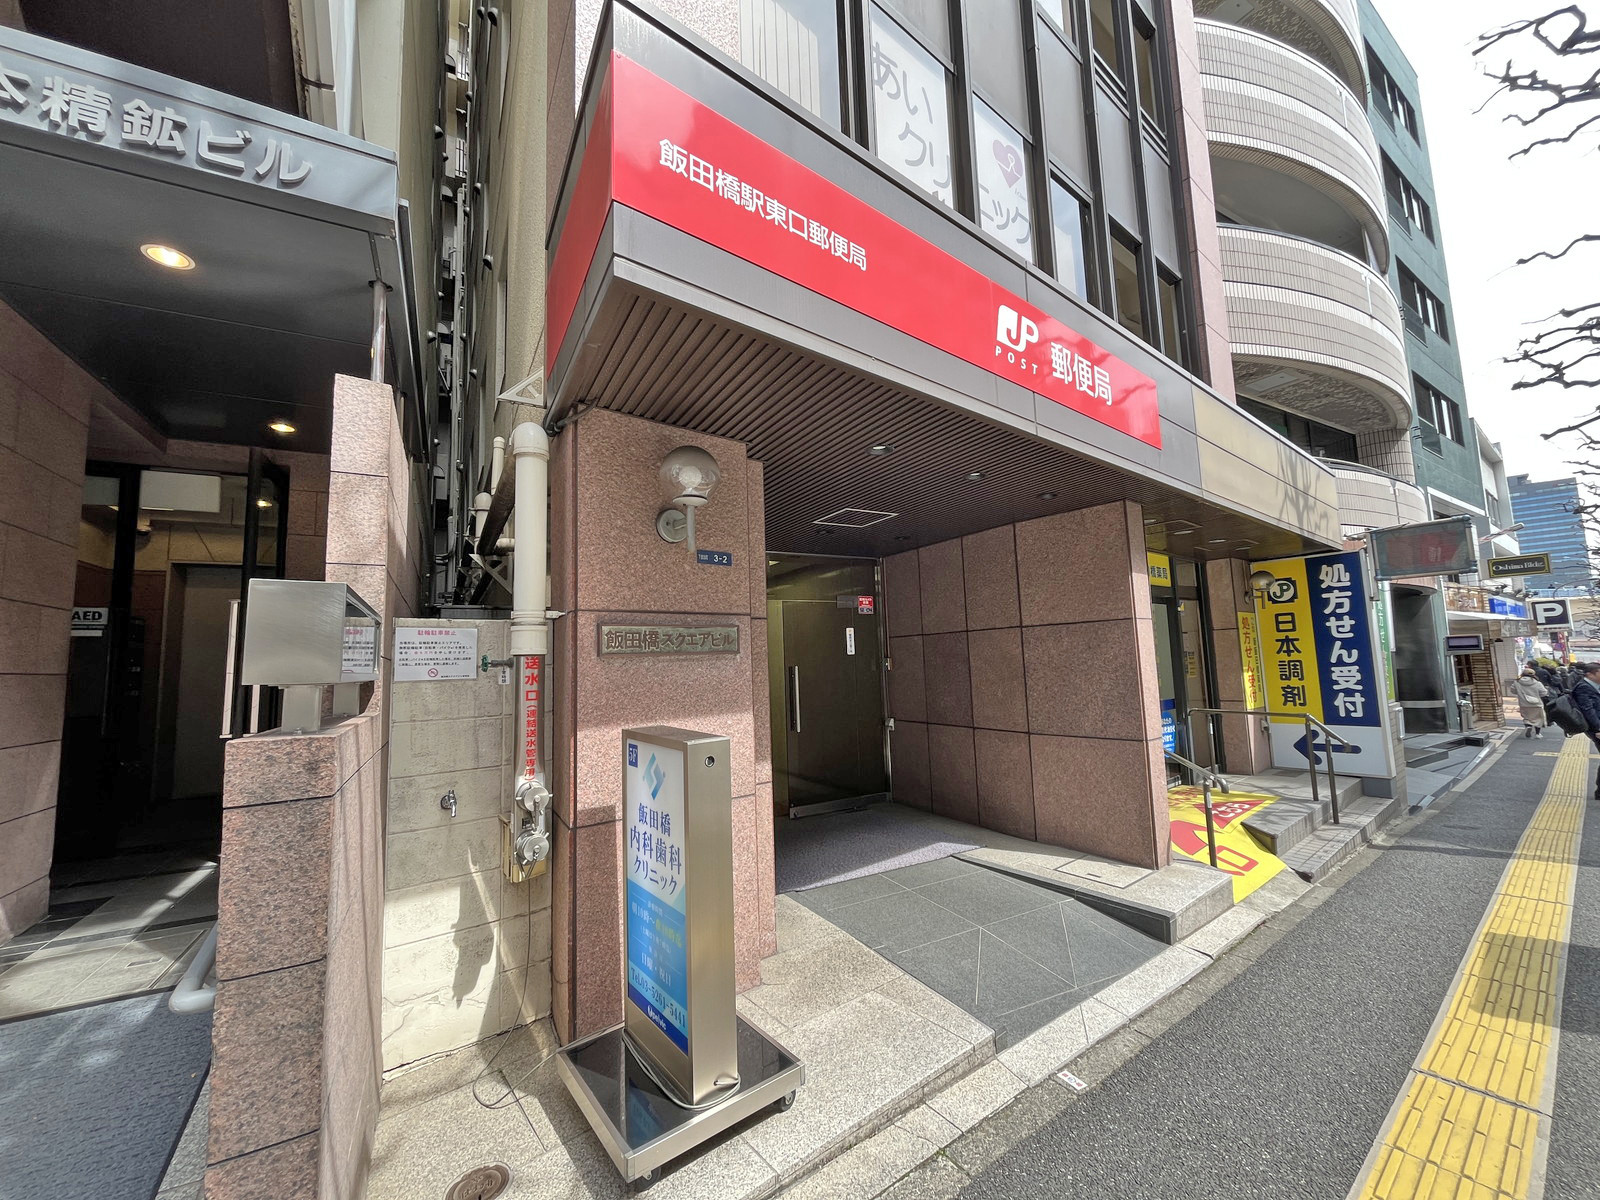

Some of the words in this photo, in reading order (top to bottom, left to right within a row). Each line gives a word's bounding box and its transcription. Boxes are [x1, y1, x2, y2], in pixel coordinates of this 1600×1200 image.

[872, 42, 933, 124] あい
[659, 138, 867, 271] 飯田橋駅東口郵便局
[995, 345, 1038, 374] POST
[1050, 341, 1113, 406] 郵便局
[713, 554, 728, 564] 3-2
[72, 610, 103, 621] AED
[1534, 603, 1564, 624] P
[604, 630, 735, 650] 飯田橋スクエアビル
[1241, 616, 1258, 703] 処方せん受付
[1274, 612, 1307, 707] 日本調剤
[1319, 563, 1366, 718] 処方せん受付
[629, 747, 638, 764] 5F
[638, 802, 671, 837] 飯田橋
[630, 825, 682, 875] 内科歯科
[634, 855, 677, 896] クリニック
